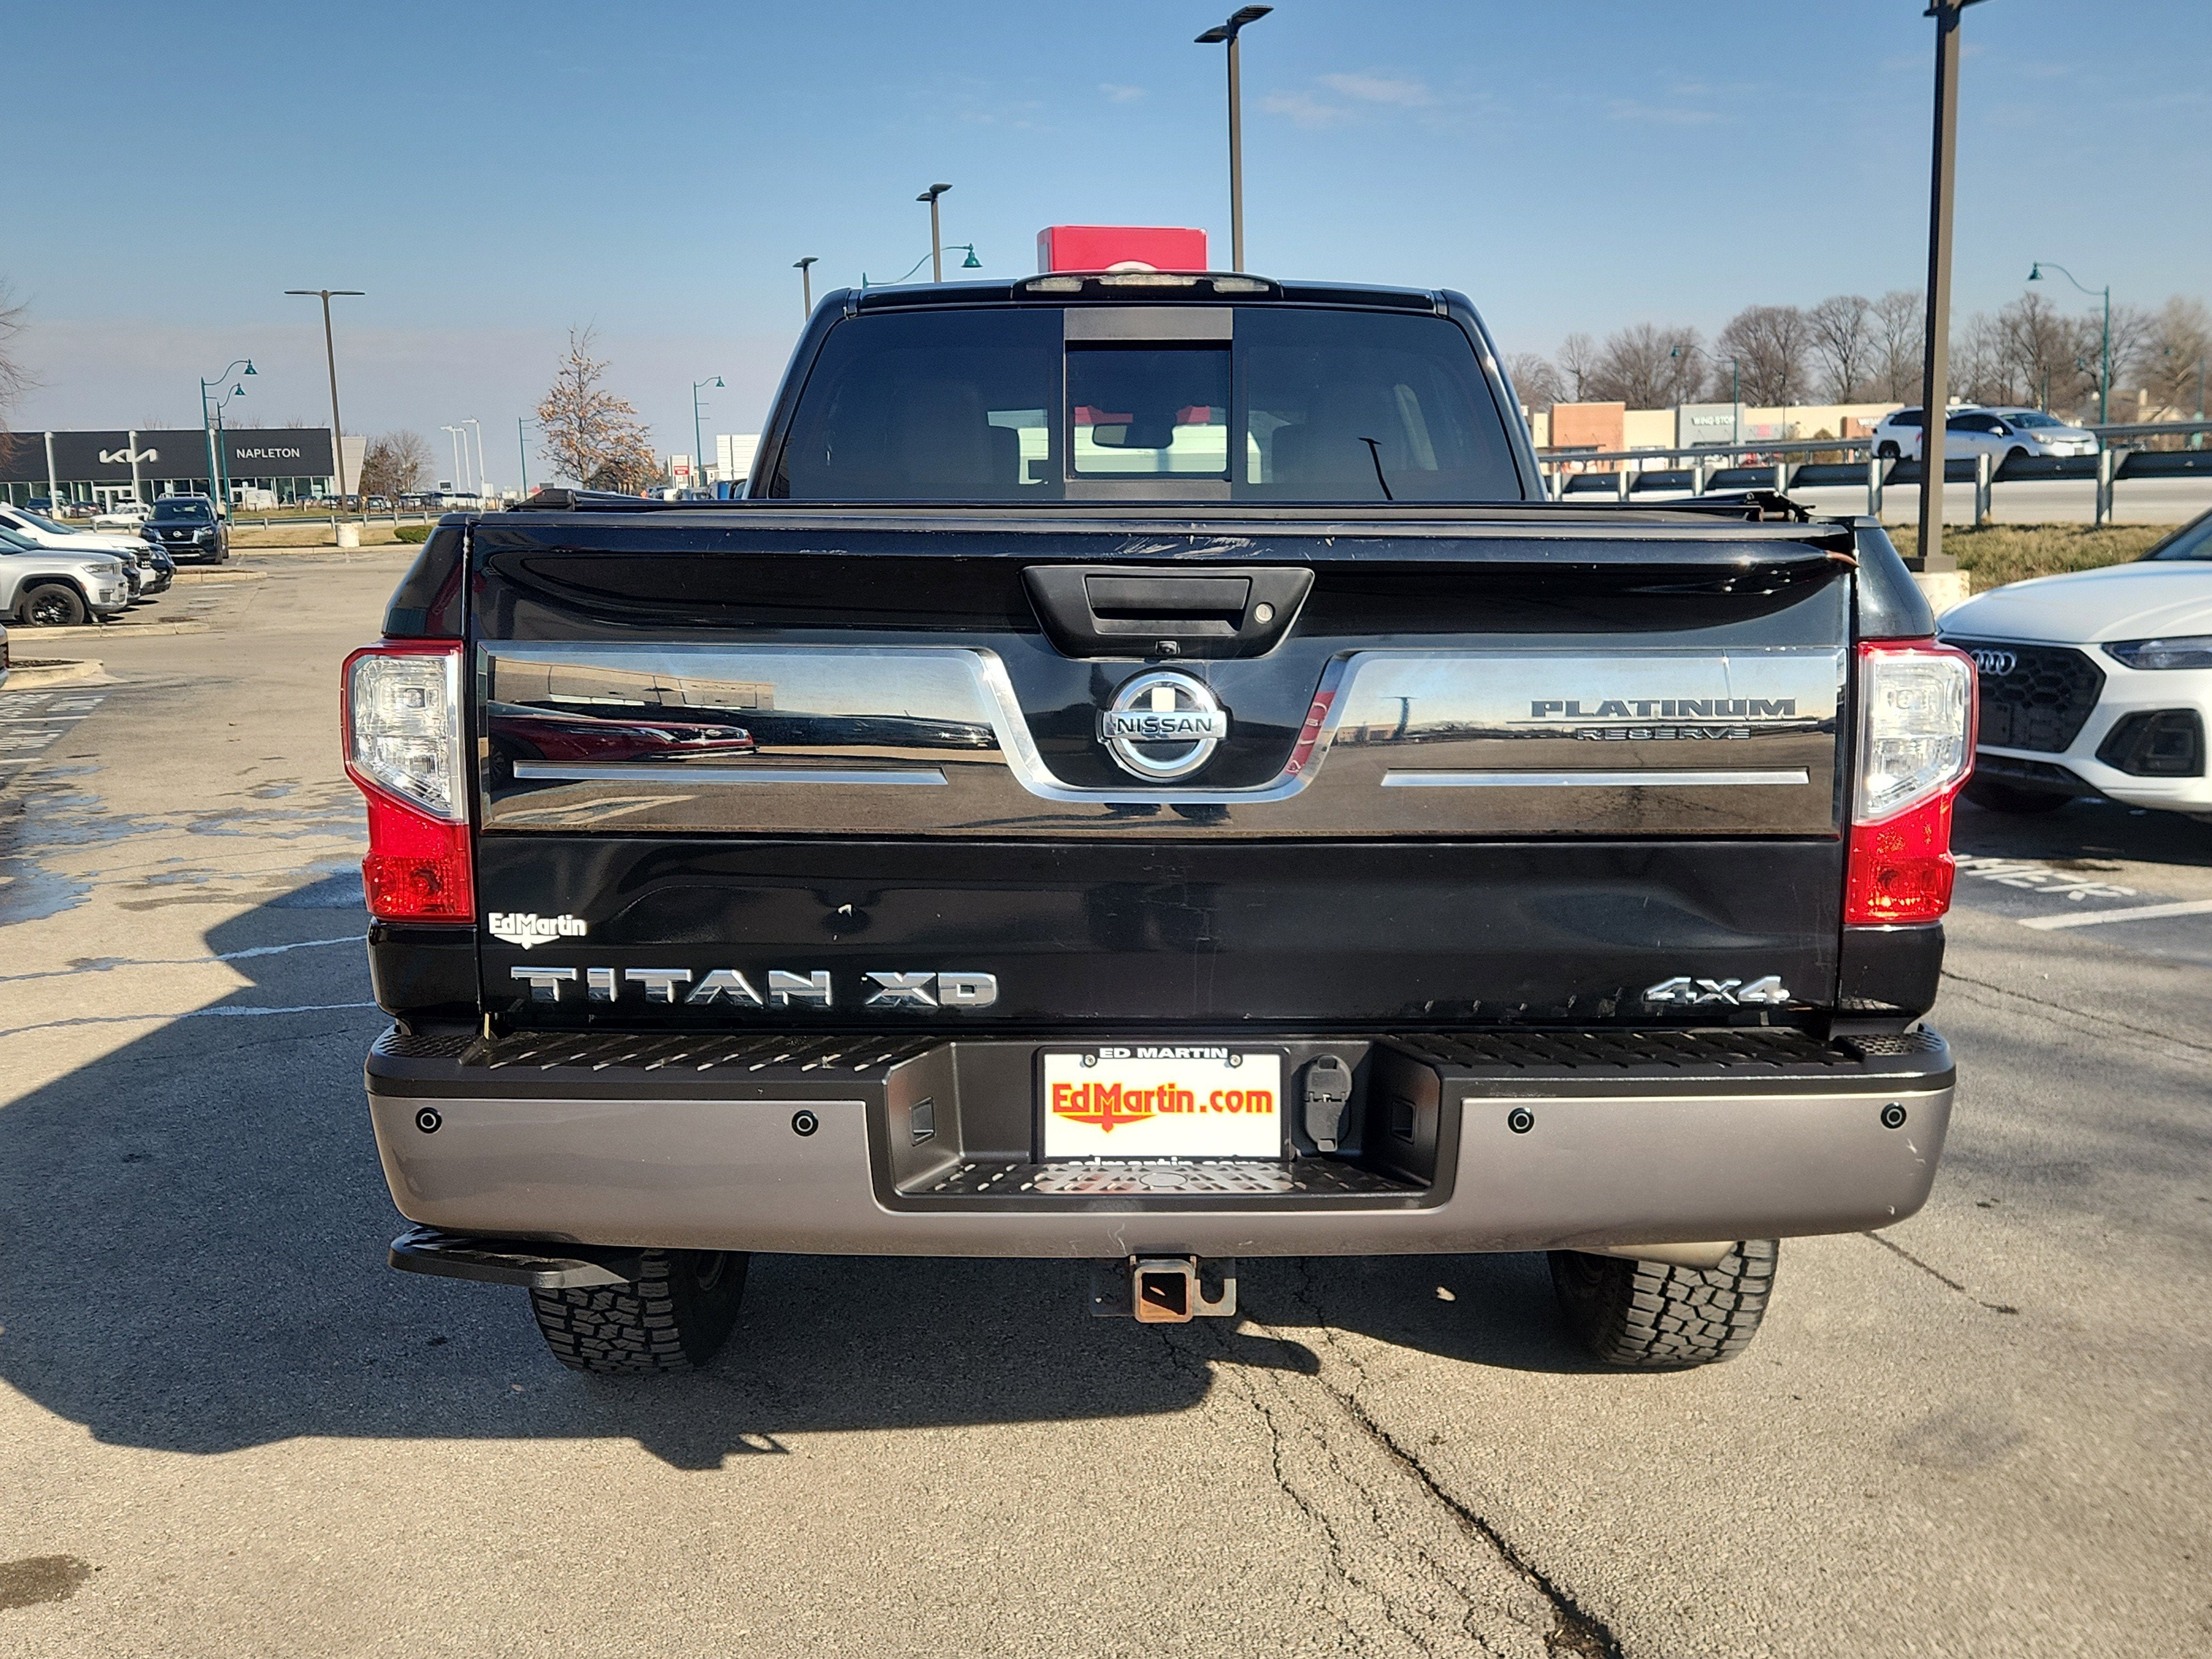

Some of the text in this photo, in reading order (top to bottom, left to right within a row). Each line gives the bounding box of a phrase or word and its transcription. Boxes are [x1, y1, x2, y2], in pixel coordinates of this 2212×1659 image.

[236, 448, 300, 458] NAPLETON
[1531, 699, 1796, 717] PLATINUM
[1116, 718, 1212, 733] NISSAN
[1576, 727, 1752, 740] RESERVE
[488, 913, 587, 937] EdMartin
[511, 966, 999, 1007] TITAN XD
[1099, 1048, 1228, 1058] ED MARTIN
[1052, 1083, 1272, 1114] EdMartin.com
